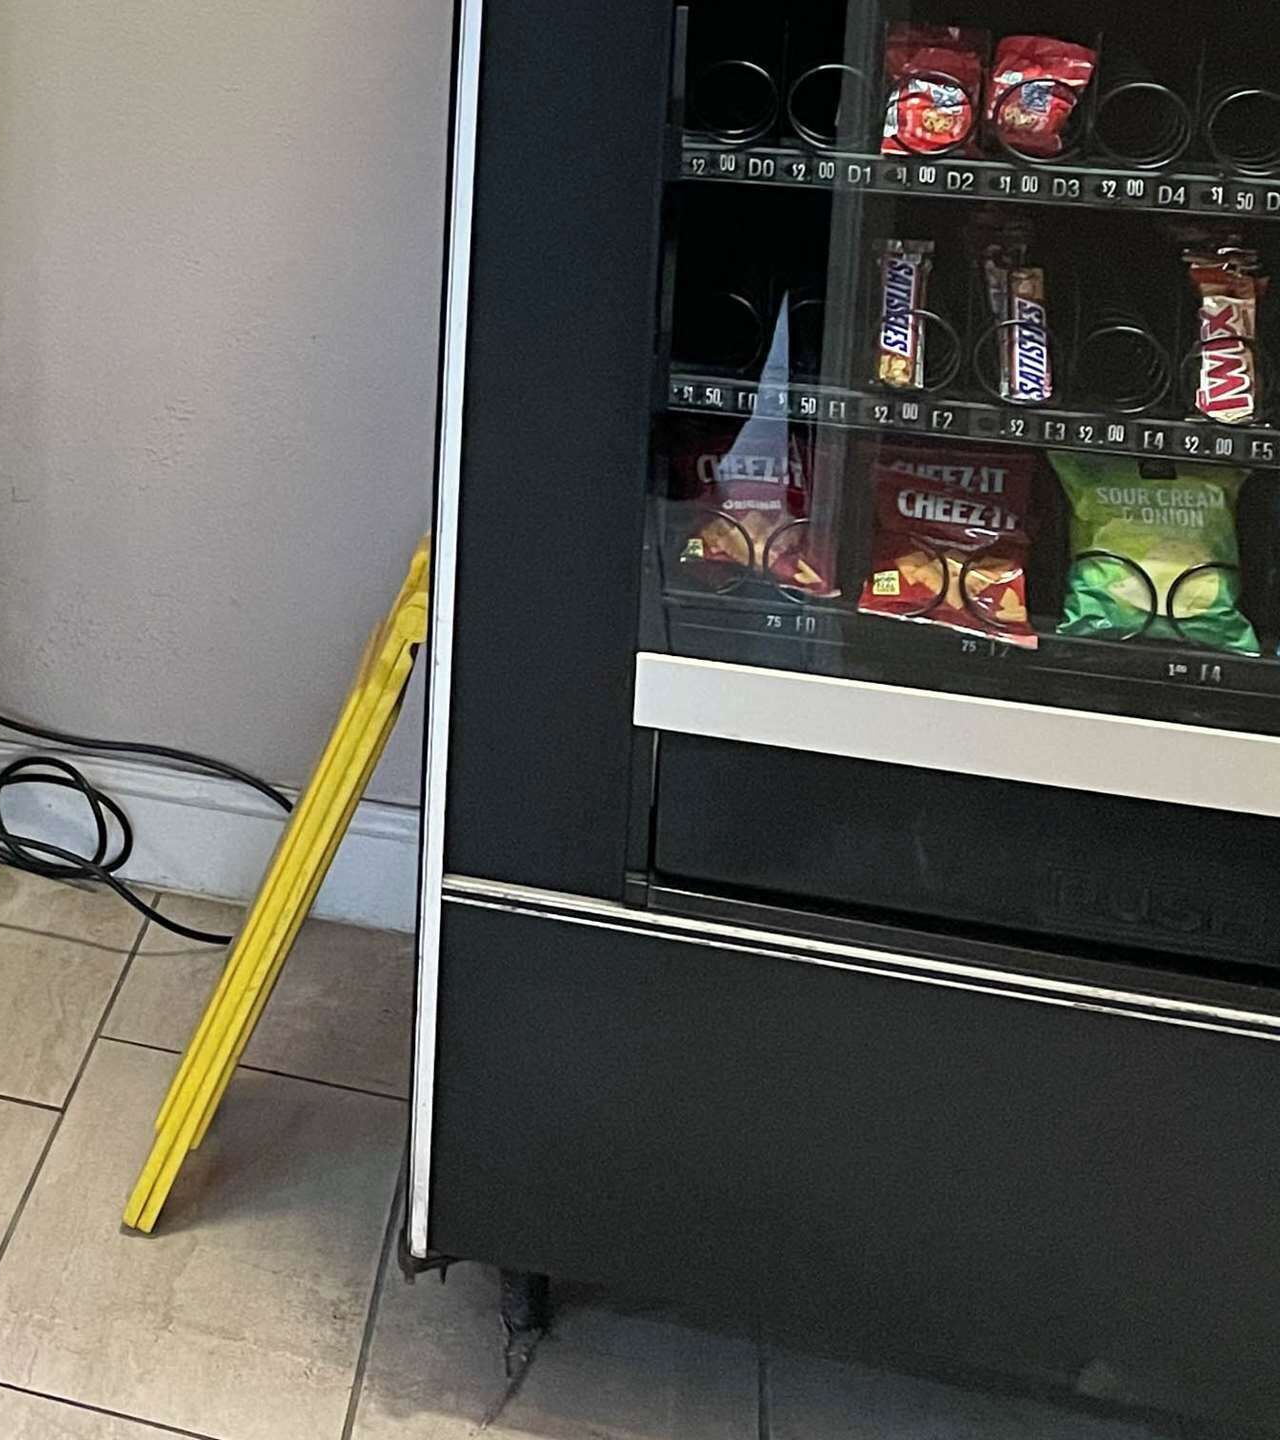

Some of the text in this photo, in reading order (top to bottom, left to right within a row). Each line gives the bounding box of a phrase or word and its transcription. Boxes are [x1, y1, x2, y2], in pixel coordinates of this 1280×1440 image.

[749, 158, 775, 178] D0
[848, 164, 872, 184] D1
[947, 171, 975, 192] D2
[1053, 178, 1080, 197] D3
[1159, 185, 1186, 205] D4
[1195, 304, 1254, 421] TWIX
[1096, 486, 1226, 510] SOUR CREAM
[1143, 508, 1205, 528] ONION
[767, 615, 782, 628] 75
[961, 641, 977, 652] 75
